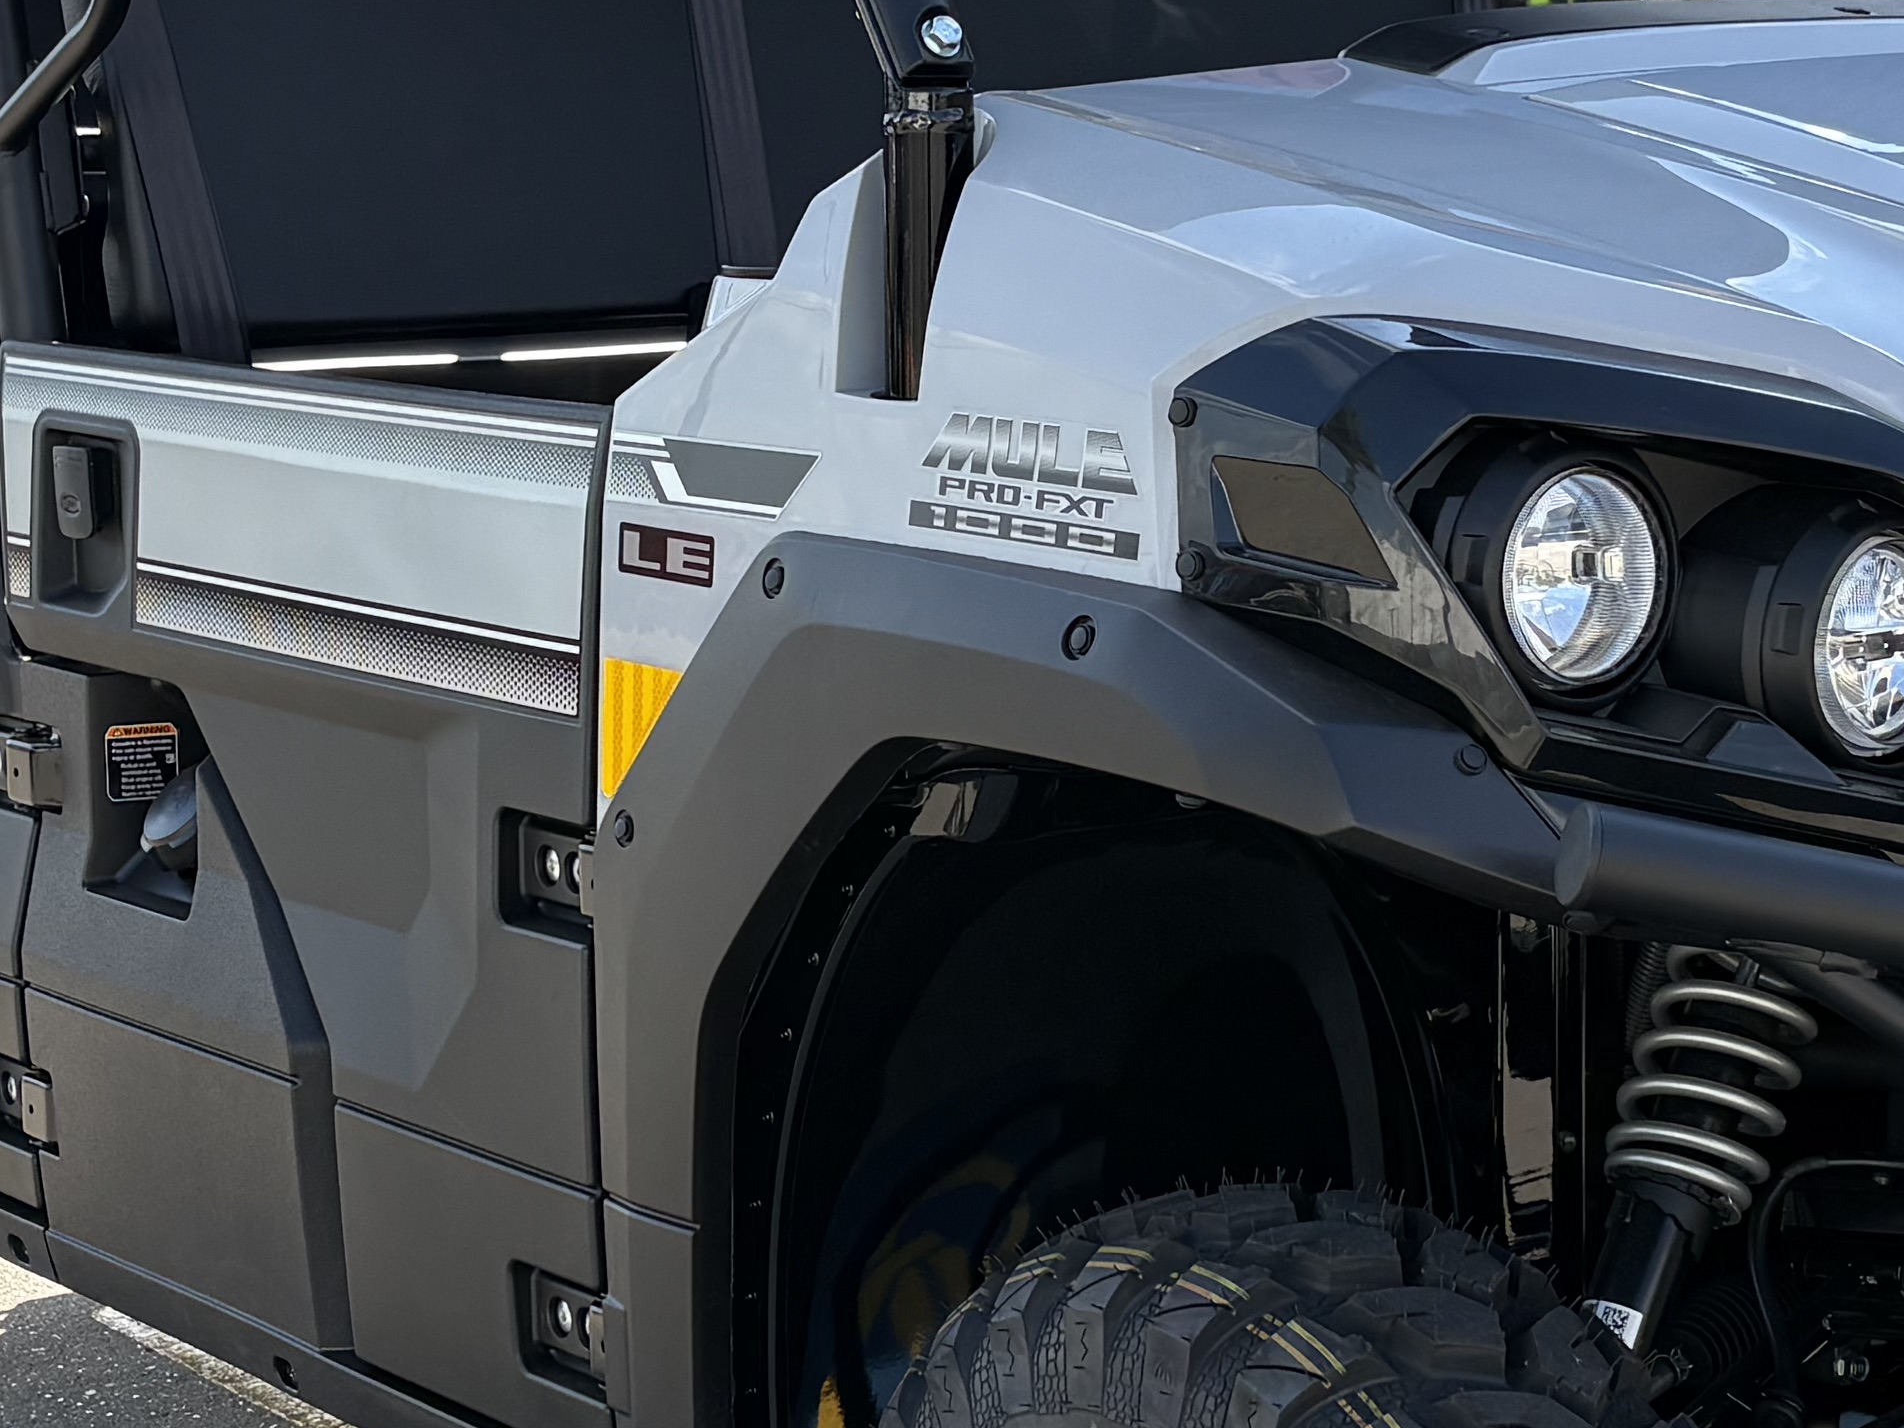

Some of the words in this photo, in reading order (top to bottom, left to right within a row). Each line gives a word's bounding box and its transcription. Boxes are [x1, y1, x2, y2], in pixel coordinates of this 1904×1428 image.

[920, 411, 1139, 497] MULE
[938, 475, 1115, 520] PRO-FXT
[622, 529, 711, 581] LE
[929, 505, 1117, 555] 1000
